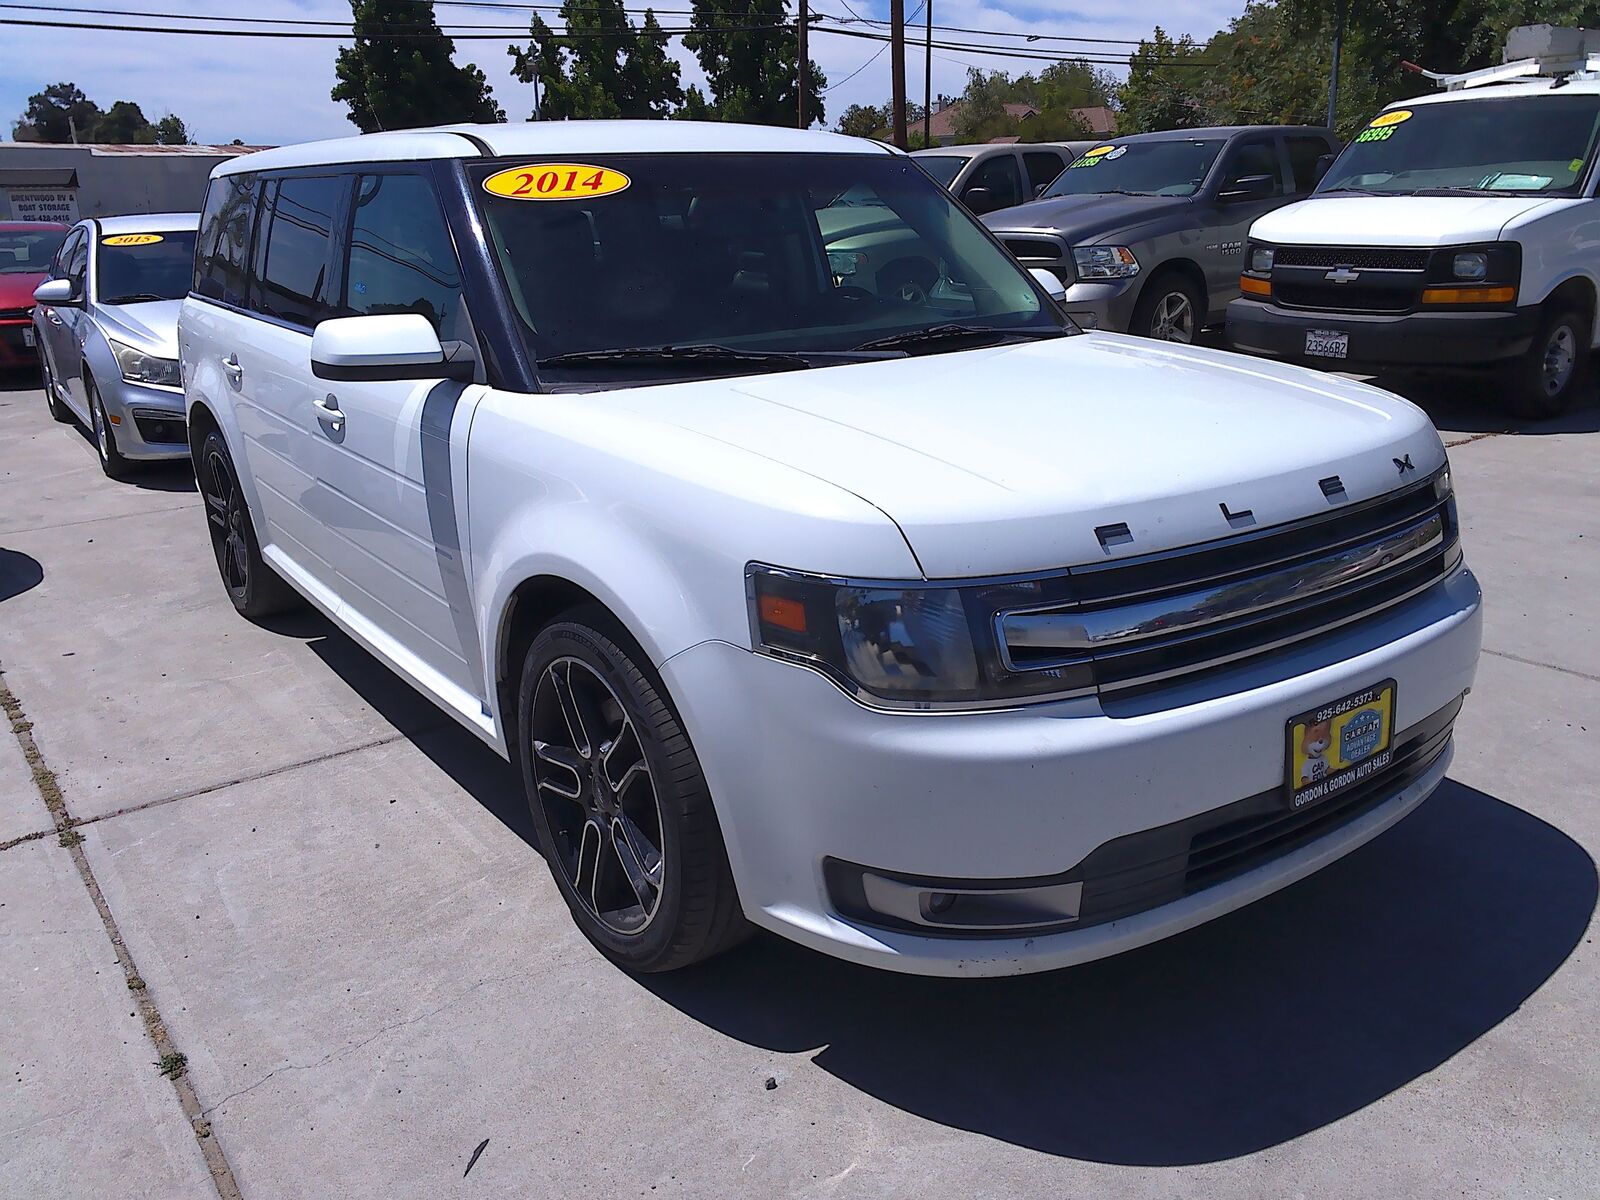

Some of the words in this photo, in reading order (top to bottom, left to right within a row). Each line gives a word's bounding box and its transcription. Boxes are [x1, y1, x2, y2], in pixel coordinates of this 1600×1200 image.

[1355, 126, 1398, 143] $6995
[512, 171, 605, 195] 2014
[11, 194, 55, 202] BRENTWOOD
[57, 194, 66, 202] RV
[69, 194, 75, 202] &
[18, 204, 36, 212] BOAT
[39, 203, 71, 211] STORAGE
[113, 236, 152, 244] 2015
[1221, 241, 1242, 249] RAM
[1307, 340, 1346, 354] 23566B2
[1316, 691, 1373, 722] 925-642-5373
[1345, 718, 1380, 741] CARFAX
[1346, 733, 1377, 752] ADVANTAGE
[1350, 745, 1371, 760] DEALER
[1312, 761, 1324, 774] CAR
[1295, 784, 1323, 806] GORDON
[1323, 782, 1329, 794] &
[1329, 769, 1356, 791] GORDON
[1356, 763, 1373, 780] AUTO
[1372, 752, 1390, 770] SALES
